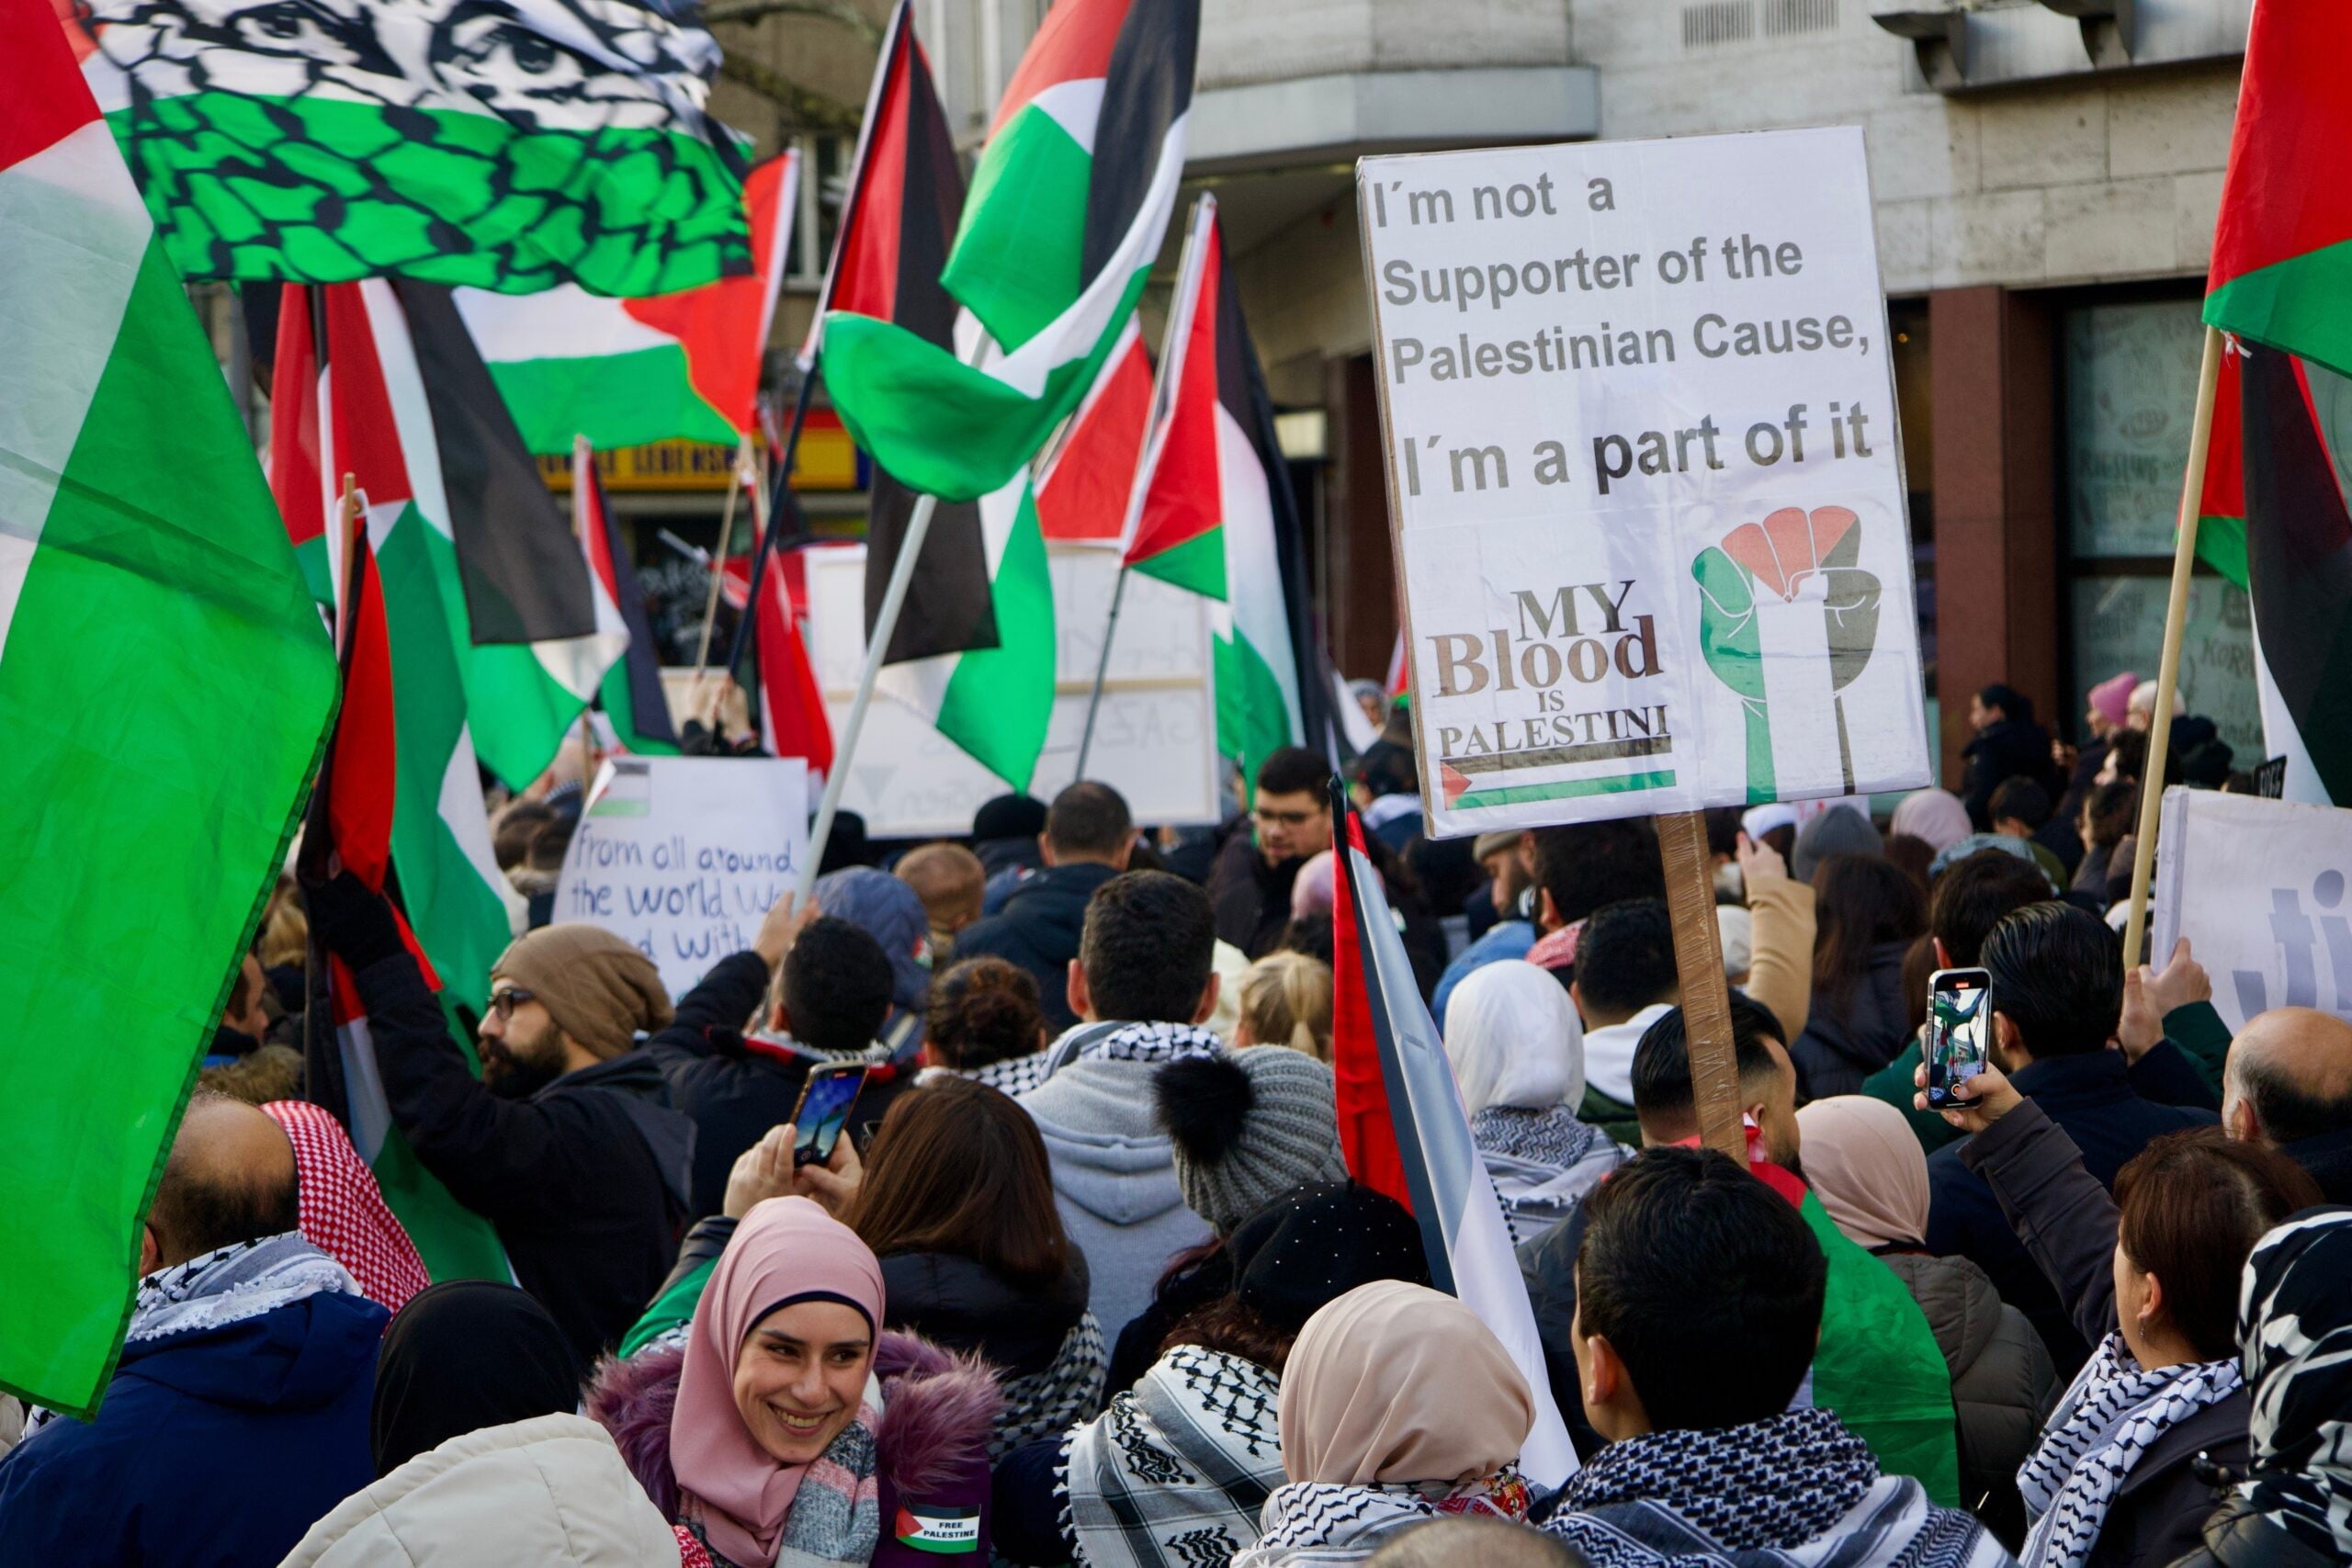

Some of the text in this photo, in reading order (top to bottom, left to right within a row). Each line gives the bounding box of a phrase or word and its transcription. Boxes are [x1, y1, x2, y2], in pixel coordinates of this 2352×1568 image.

[1473, 172, 1556, 220] not
[1587, 177, 1616, 211] a
[1384, 234, 1804, 311] Supporter of the
[1392, 312, 1870, 384] Palestinian Cause,
[1532, 437, 1570, 486] a
[1592, 414, 1725, 495] part
[1744, 404, 1808, 467] of
[1829, 400, 1873, 459] it
[1510, 580, 1636, 642] MY
[1426, 615, 1664, 698] Blood
[1538, 690, 1566, 714] IS
[653, 833, 686, 871] all
[698, 839, 797, 873] around
[571, 879, 613, 917] the
[923, 1529, 975, 1539] PALESTINE
